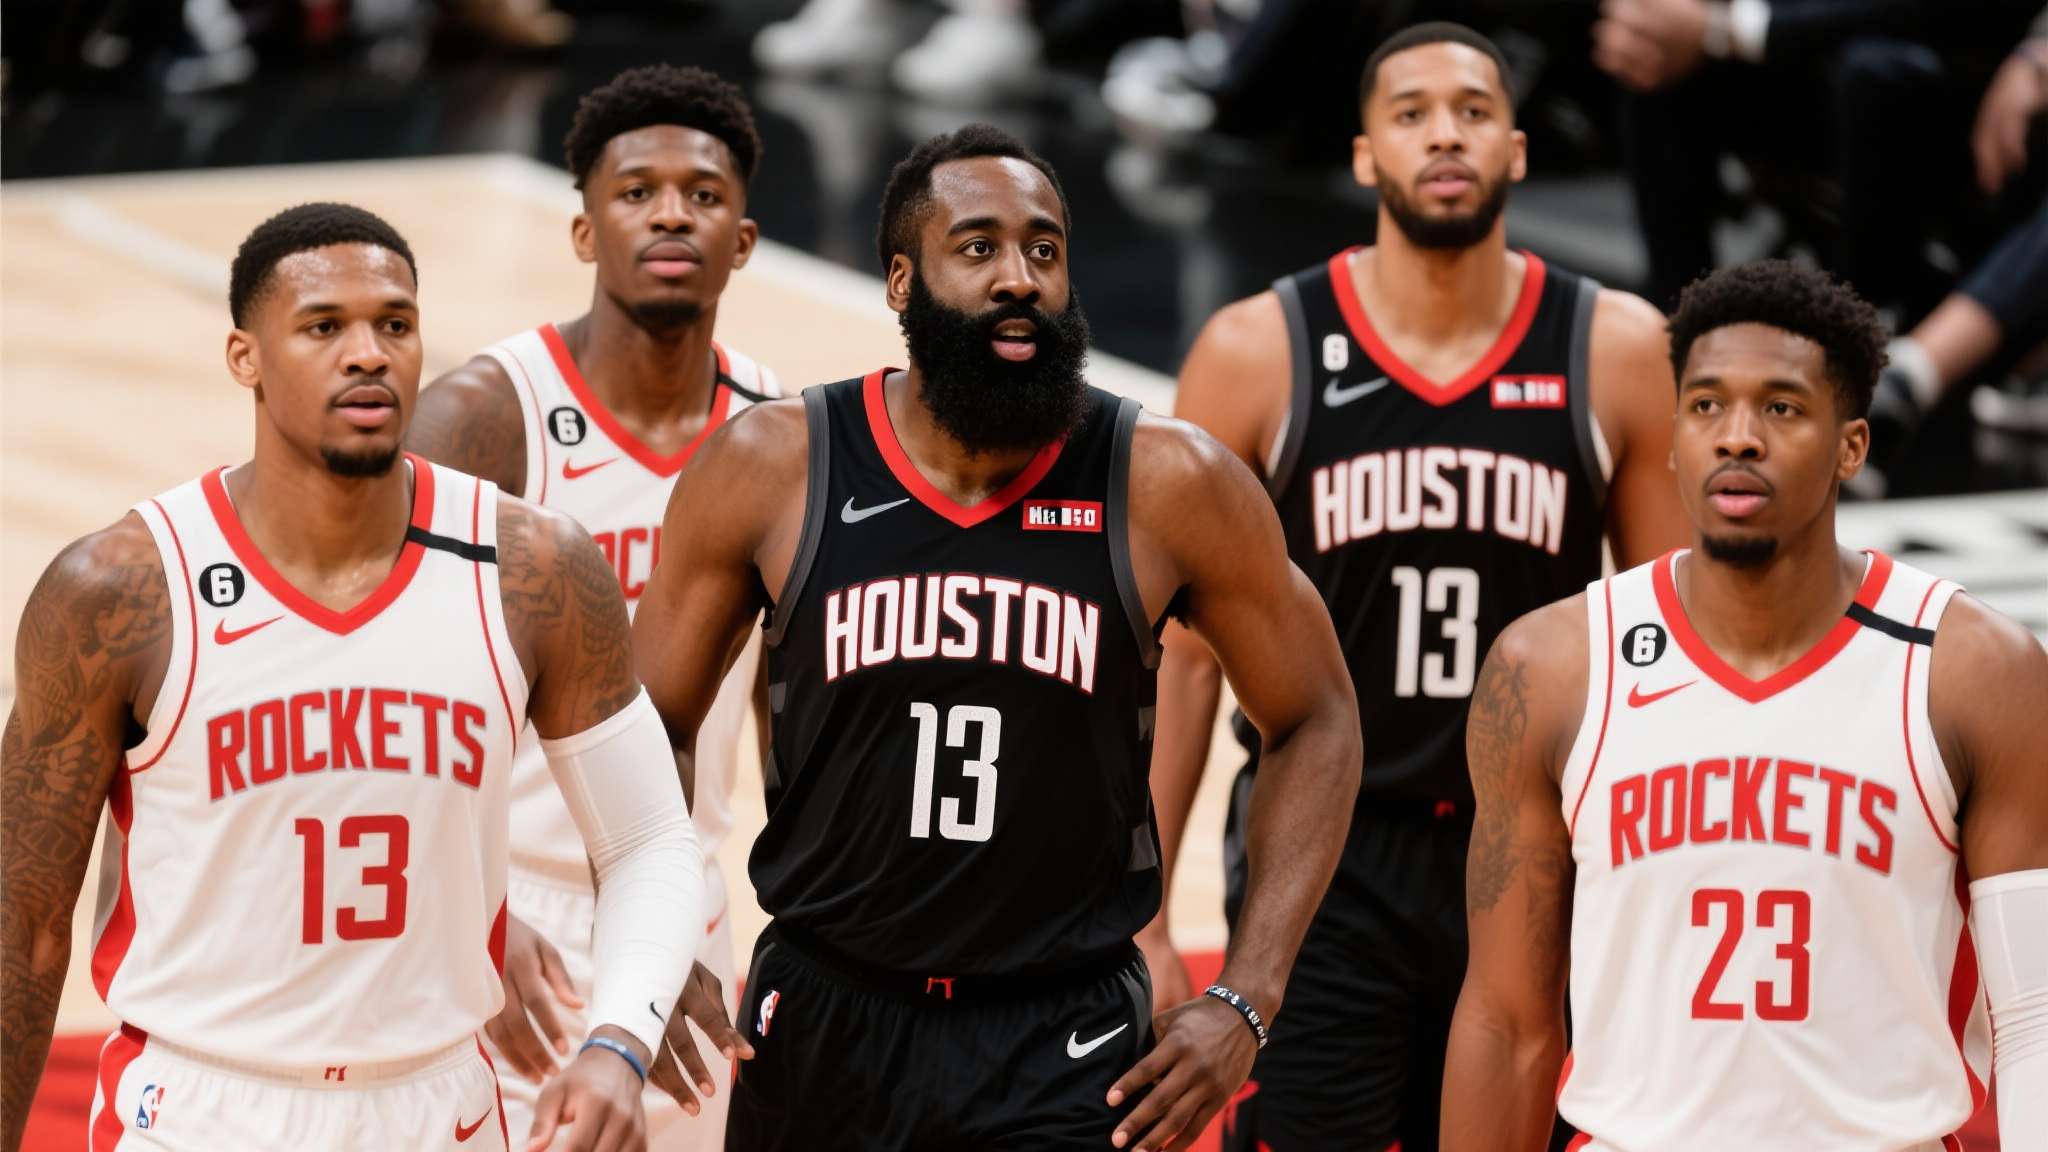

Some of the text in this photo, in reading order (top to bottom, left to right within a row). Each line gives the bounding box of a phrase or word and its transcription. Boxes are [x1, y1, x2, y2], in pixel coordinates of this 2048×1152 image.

[555, 410, 580, 443] 6
[1313, 446, 1567, 554] HOUSTON
[210, 567, 235, 604] 6
[824, 572, 1101, 694] HOUSTON
[1392, 567, 1480, 698] 13
[1632, 626, 1658, 664] 6
[207, 687, 487, 801] ROCKETS
[909, 702, 1002, 842] 13
[1609, 756, 1899, 876] ROCKETS
[294, 813, 411, 946] 13
[1690, 887, 1812, 1023] 23
